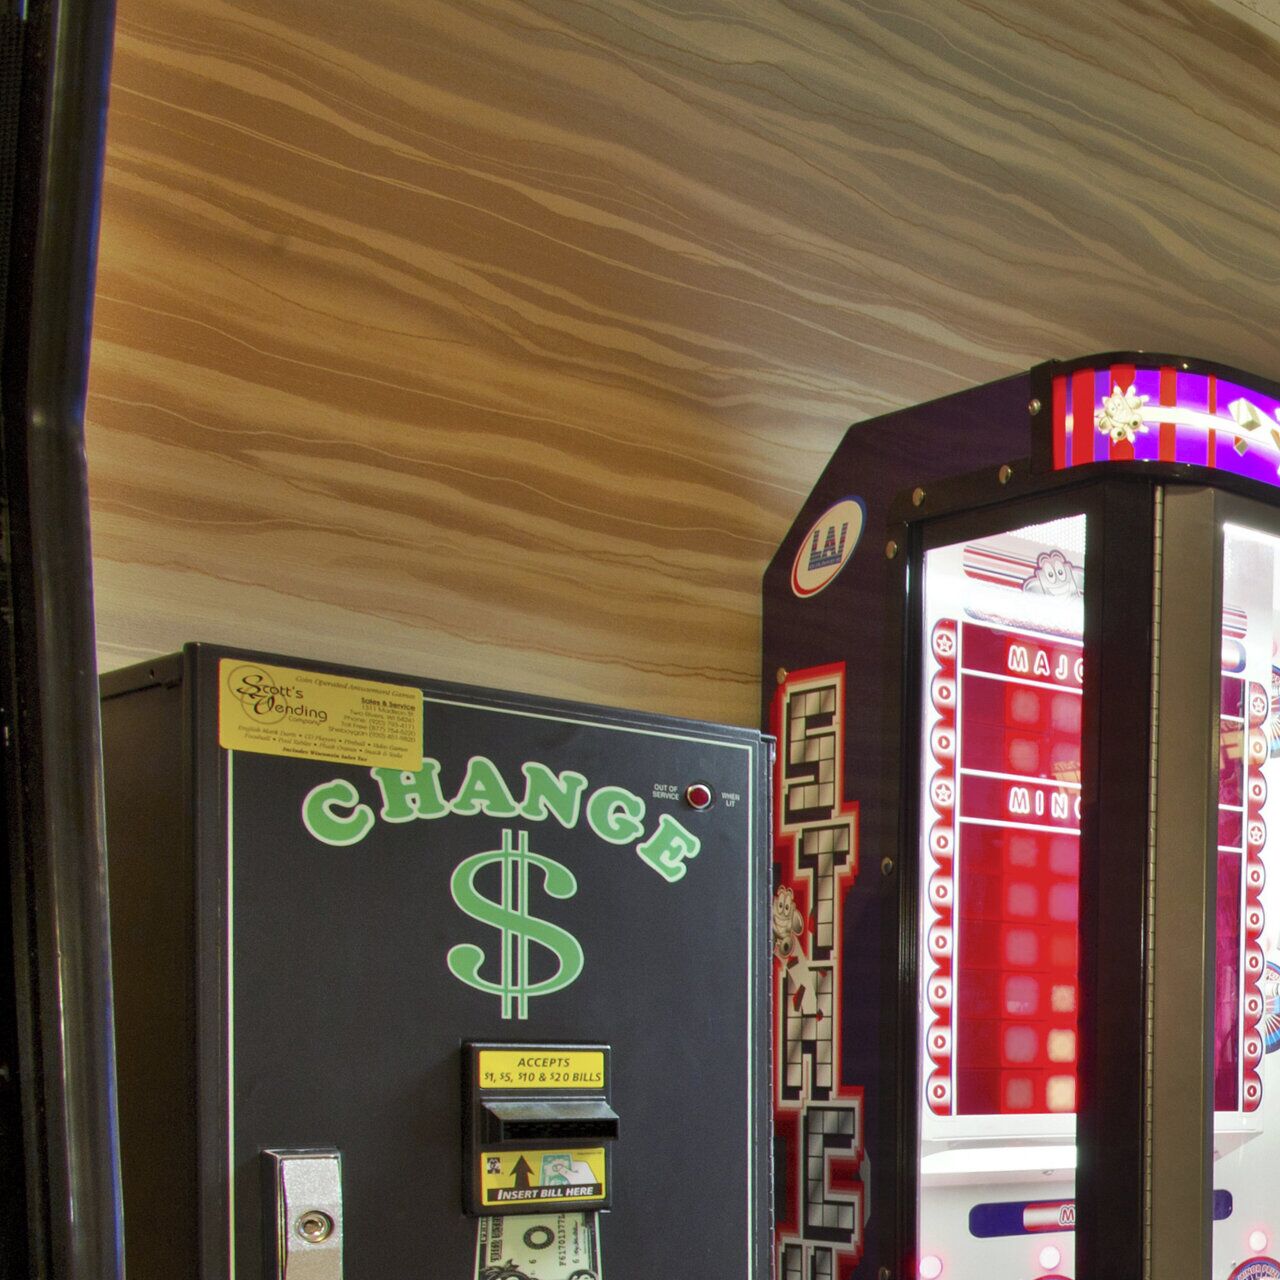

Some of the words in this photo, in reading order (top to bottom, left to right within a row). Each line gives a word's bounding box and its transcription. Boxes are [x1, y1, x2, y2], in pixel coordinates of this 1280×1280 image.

[236, 674, 304, 699] Scott's
[252, 694, 328, 723] Vending
[654, 783, 667, 792] OUT
[652, 790, 680, 800] SERVICE
[721, 791, 740, 801] WHEN
[301, 756, 702, 883] CHANGE
[517, 1057, 571, 1068] ACCEPTS
[484, 1072, 496, 1084] $1,
[500, 1072, 514, 1084] $5,
[518, 1071, 535, 1082] $10
[538, 1072, 546, 1082] &
[550, 1071, 570, 1082] $20
[572, 1071, 601, 1082] BILLS
[497, 1189, 539, 1201] INSERT
[540, 1188, 564, 1199] BILL
[565, 1186, 594, 1197] HERE
